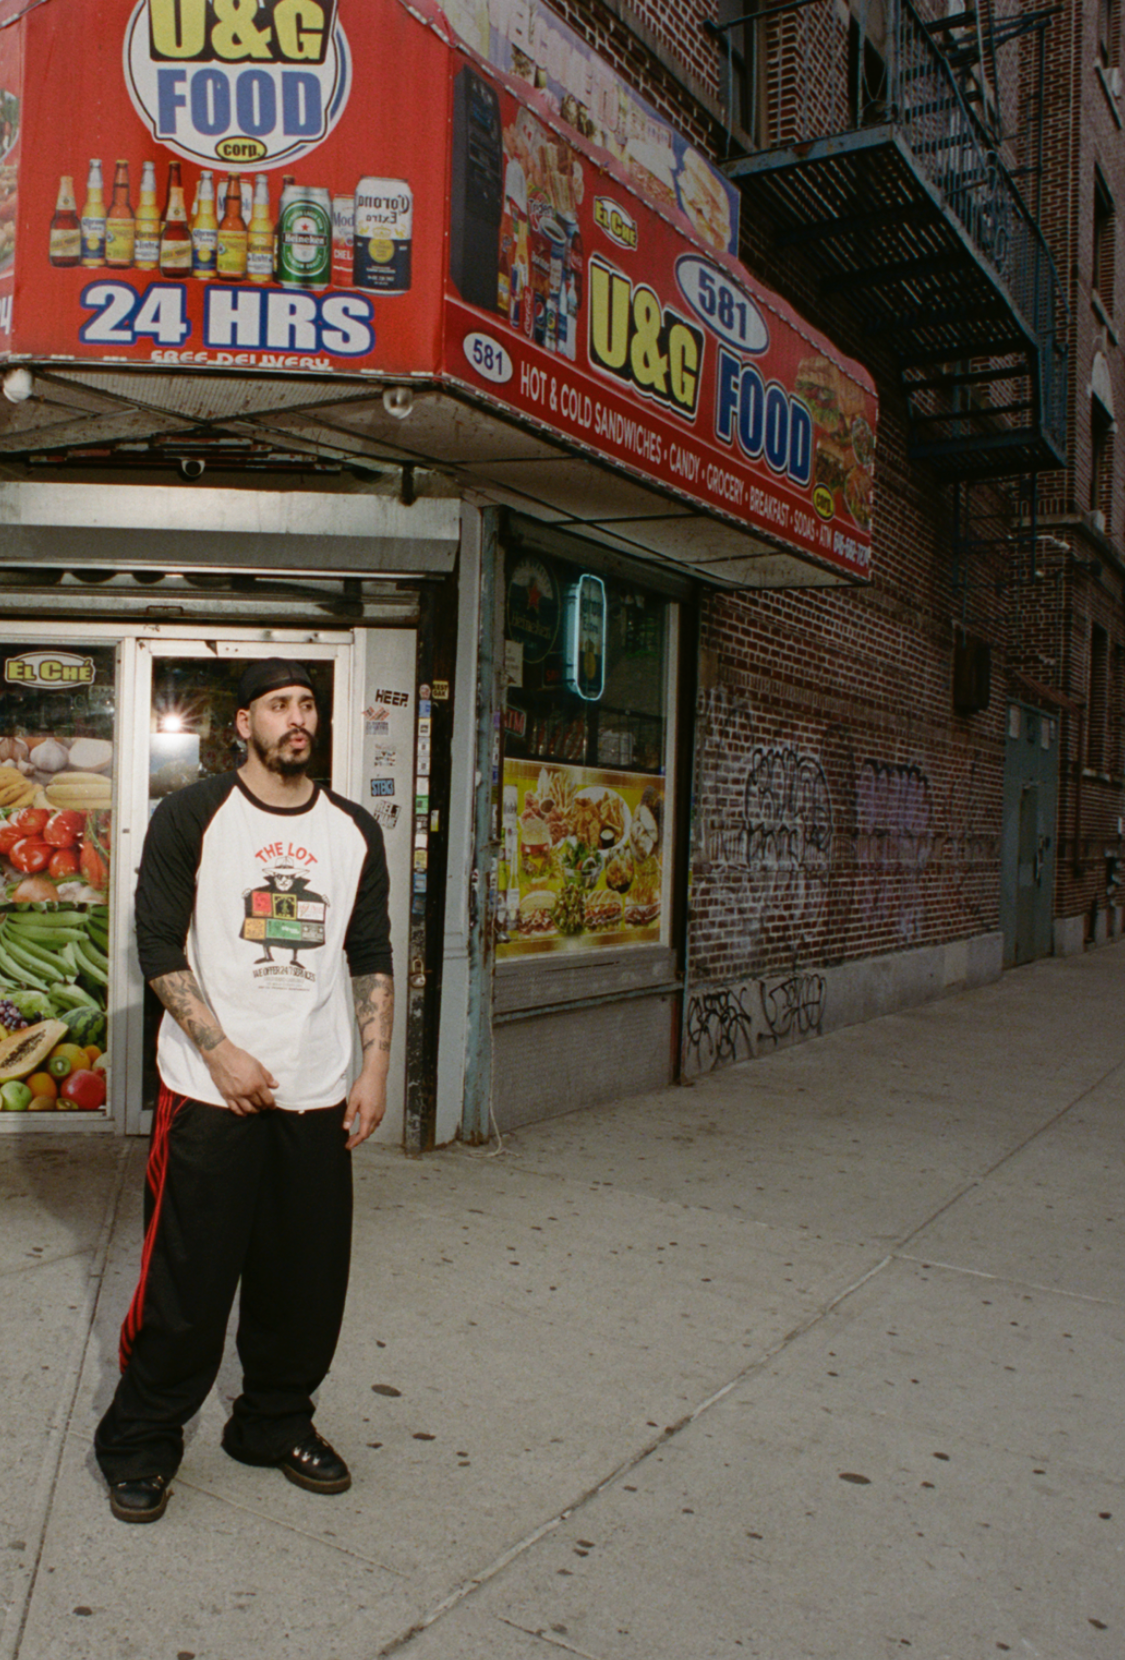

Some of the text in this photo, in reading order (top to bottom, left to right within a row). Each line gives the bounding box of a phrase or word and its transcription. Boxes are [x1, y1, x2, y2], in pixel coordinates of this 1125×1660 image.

[149, 0, 325, 61] U&G
[157, 68, 323, 137] FOOD
[222, 140, 261, 160] corp.
[285, 233, 325, 245] Heineken
[81, 281, 373, 357] 24 HRS
[698, 267, 747, 341] 581
[151, 350, 208, 363] FREE
[473, 338, 503, 376] 581
[591, 263, 698, 408] U&G
[717, 347, 811, 484] FOOD
[520, 360, 548, 406] HOT
[550, 376, 558, 412] &
[560, 383, 593, 430] COLD
[594, 401, 662, 466] SANDWICHES
[669, 442, 702, 484] CANDY
[706, 462, 745, 506] GROCERY
[749, 485, 790, 528] BREAKFAST
[793, 508, 816, 542] SODAS
[254, 841, 319, 867] THE LOT
[263, 965, 280, 976] OFFER
